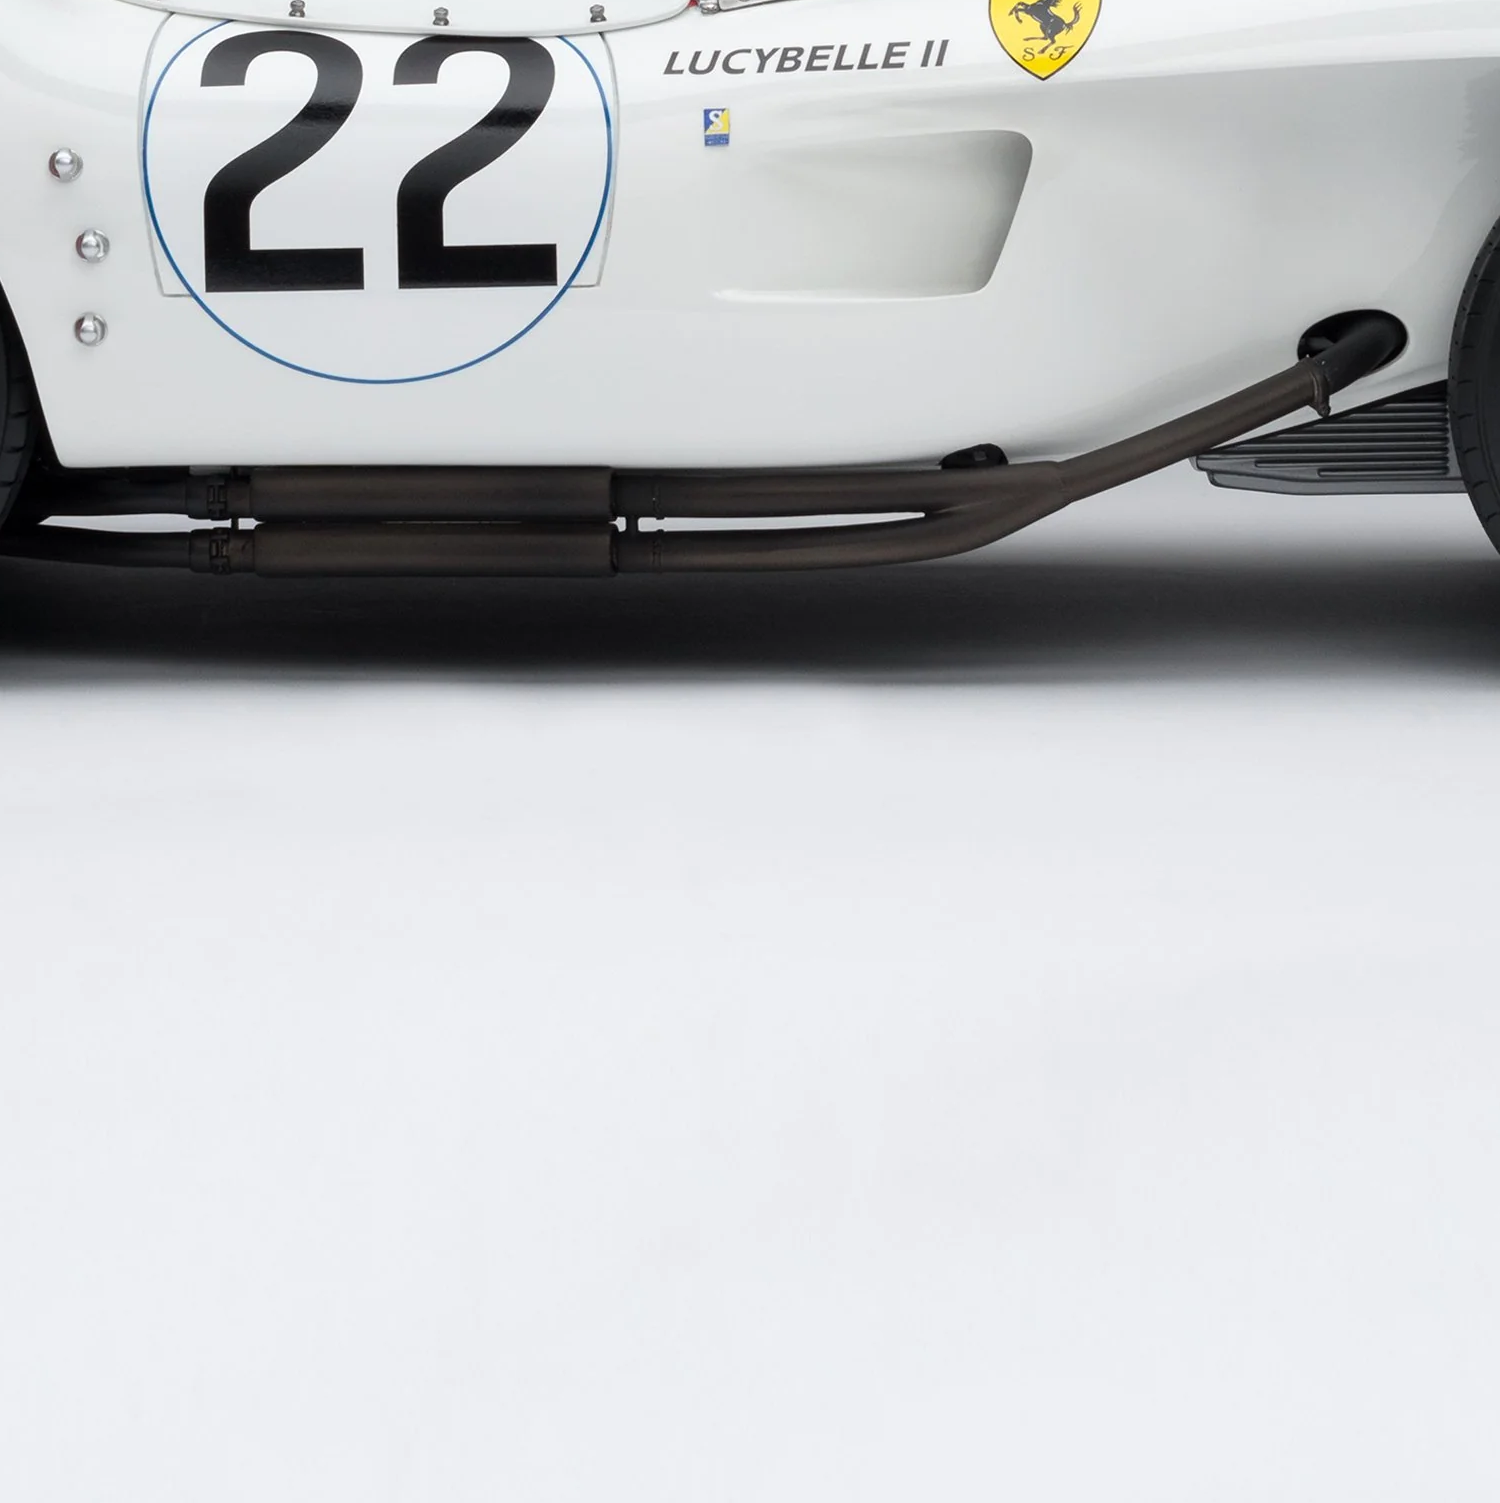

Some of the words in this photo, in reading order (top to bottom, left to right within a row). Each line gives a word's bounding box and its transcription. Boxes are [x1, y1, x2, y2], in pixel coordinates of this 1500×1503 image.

[663, 41, 911, 75] LUCYBELLE
[920, 39, 949, 68] II
[1021, 46, 1036, 62] S
[1048, 44, 1075, 61] F
[200, 30, 558, 293] 22
